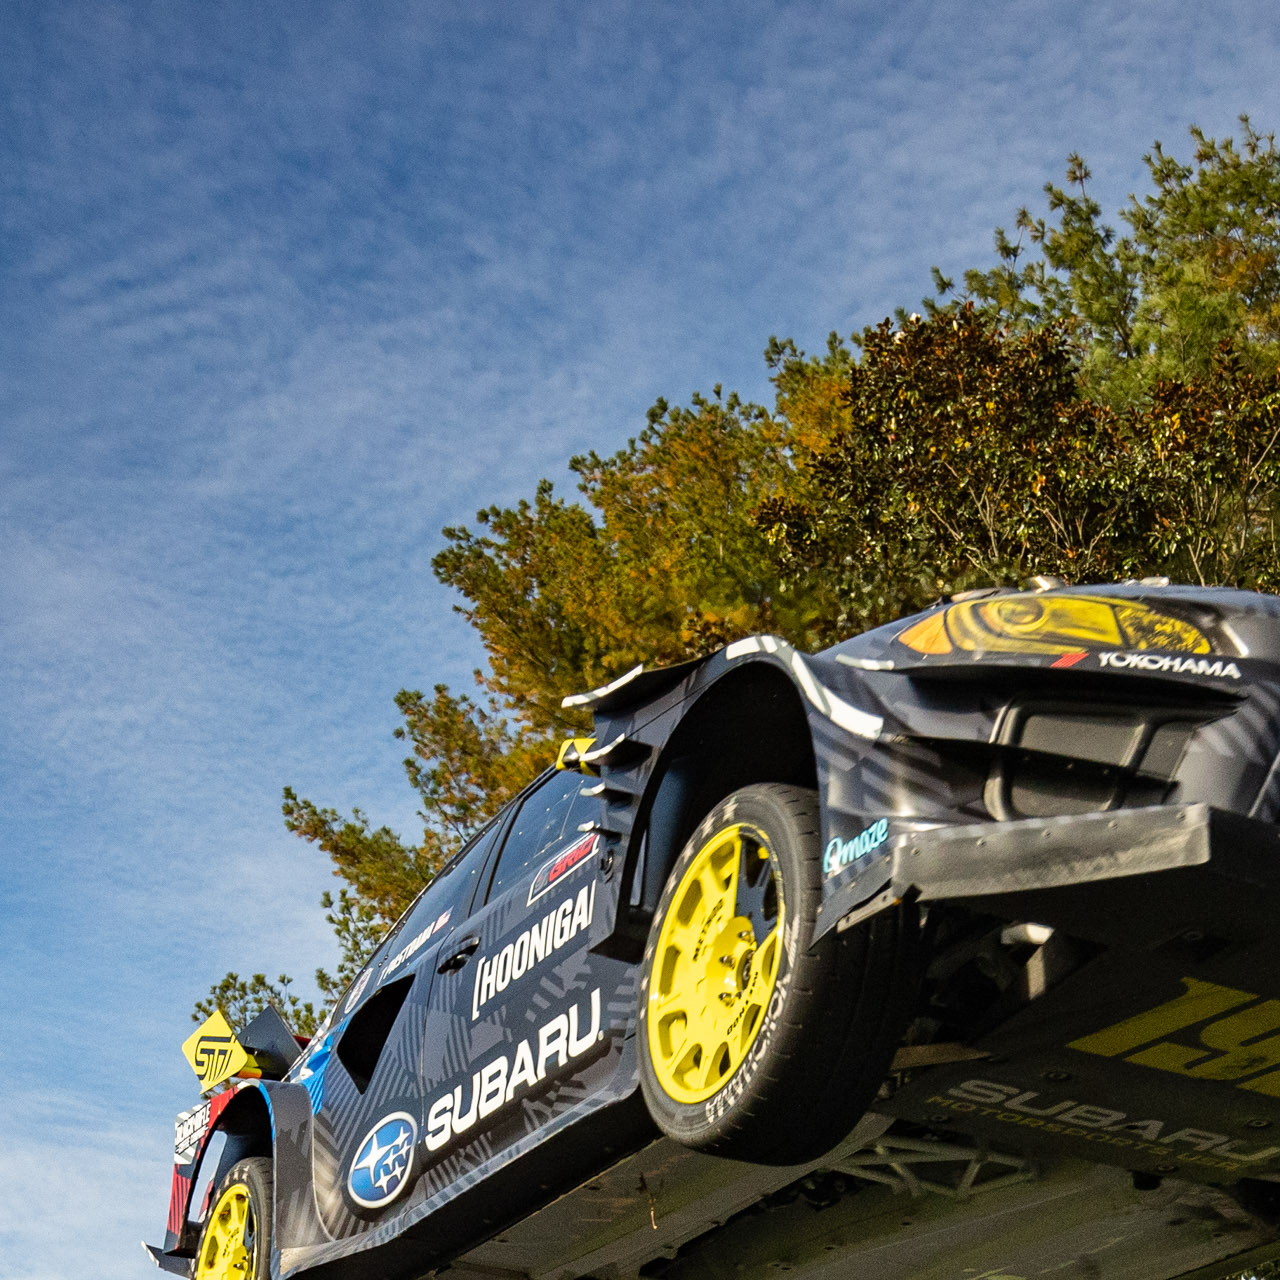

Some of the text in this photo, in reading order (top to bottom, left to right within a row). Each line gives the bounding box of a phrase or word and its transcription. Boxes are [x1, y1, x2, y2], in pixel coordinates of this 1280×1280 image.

[1098, 651, 1242, 679] YOKOHAMA
[823, 817, 888, 873] Omaze
[425, 987, 602, 1151] SUBARU
